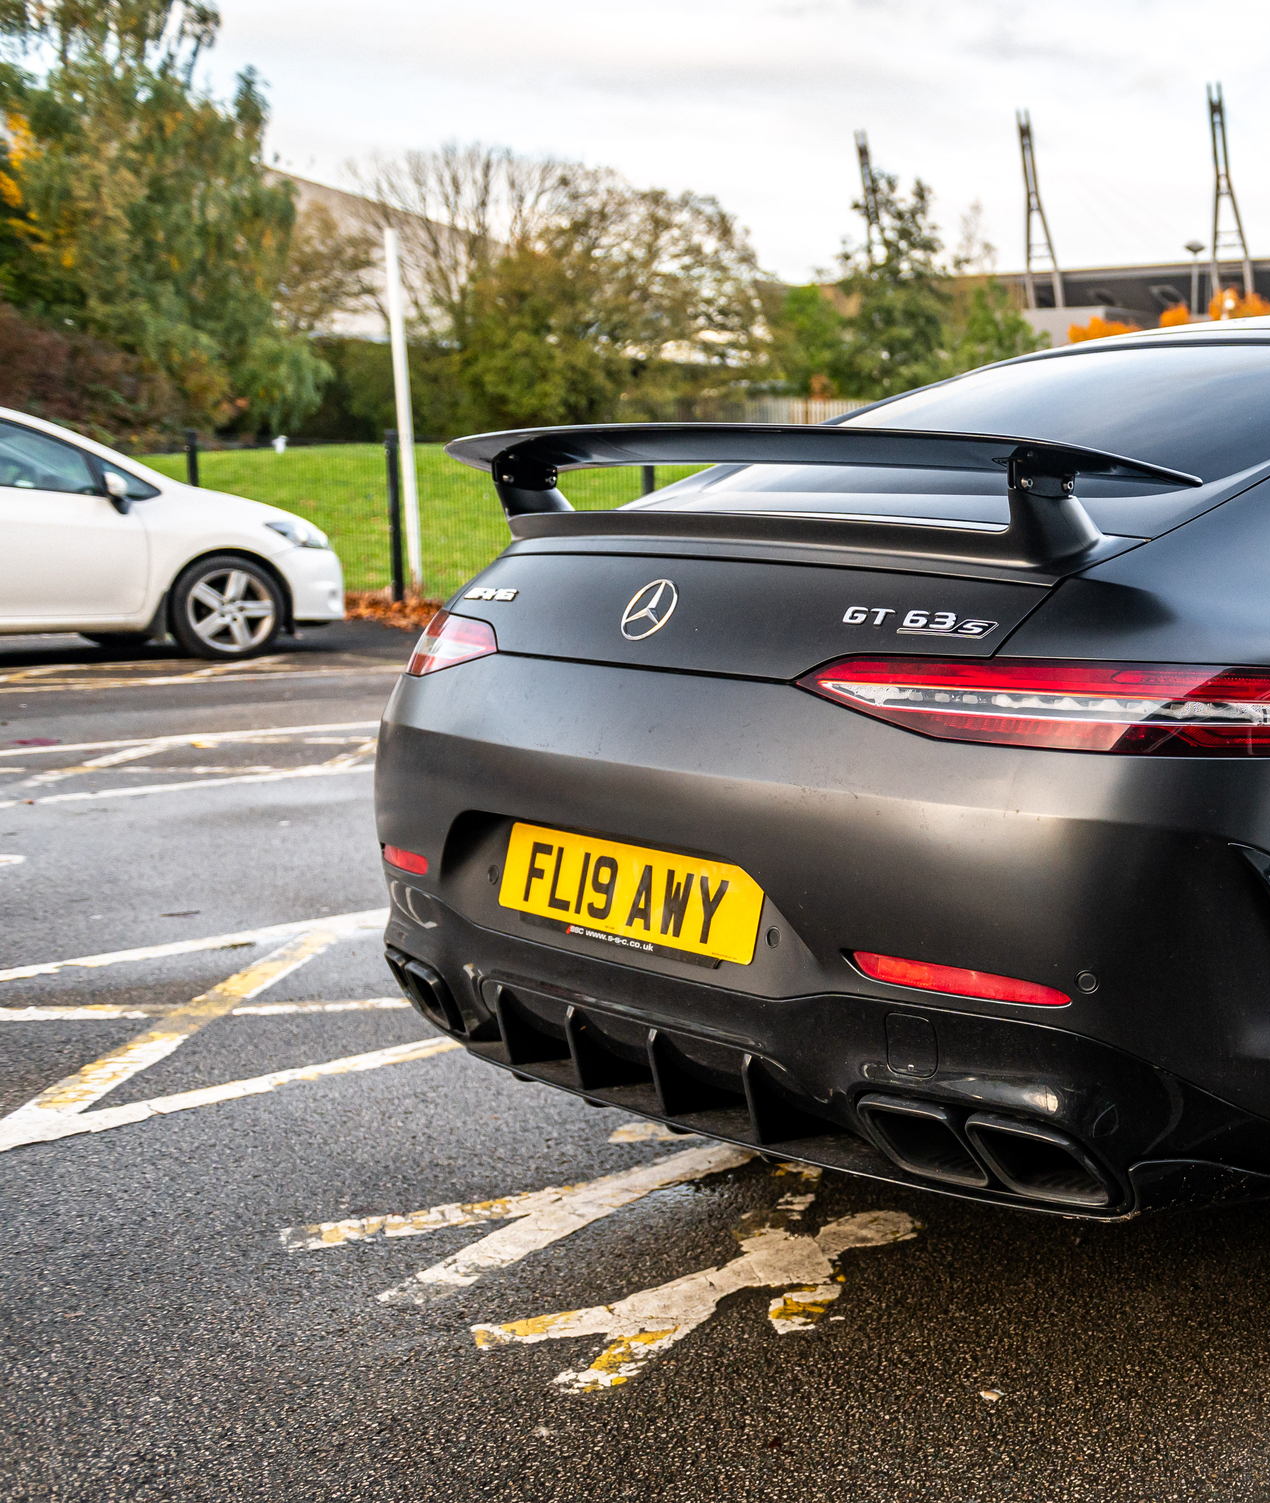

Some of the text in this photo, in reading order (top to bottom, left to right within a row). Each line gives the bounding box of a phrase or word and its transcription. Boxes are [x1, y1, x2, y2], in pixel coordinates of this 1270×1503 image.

[842, 606, 897, 626] GT
[523, 841, 730, 945] FL19 AWY
